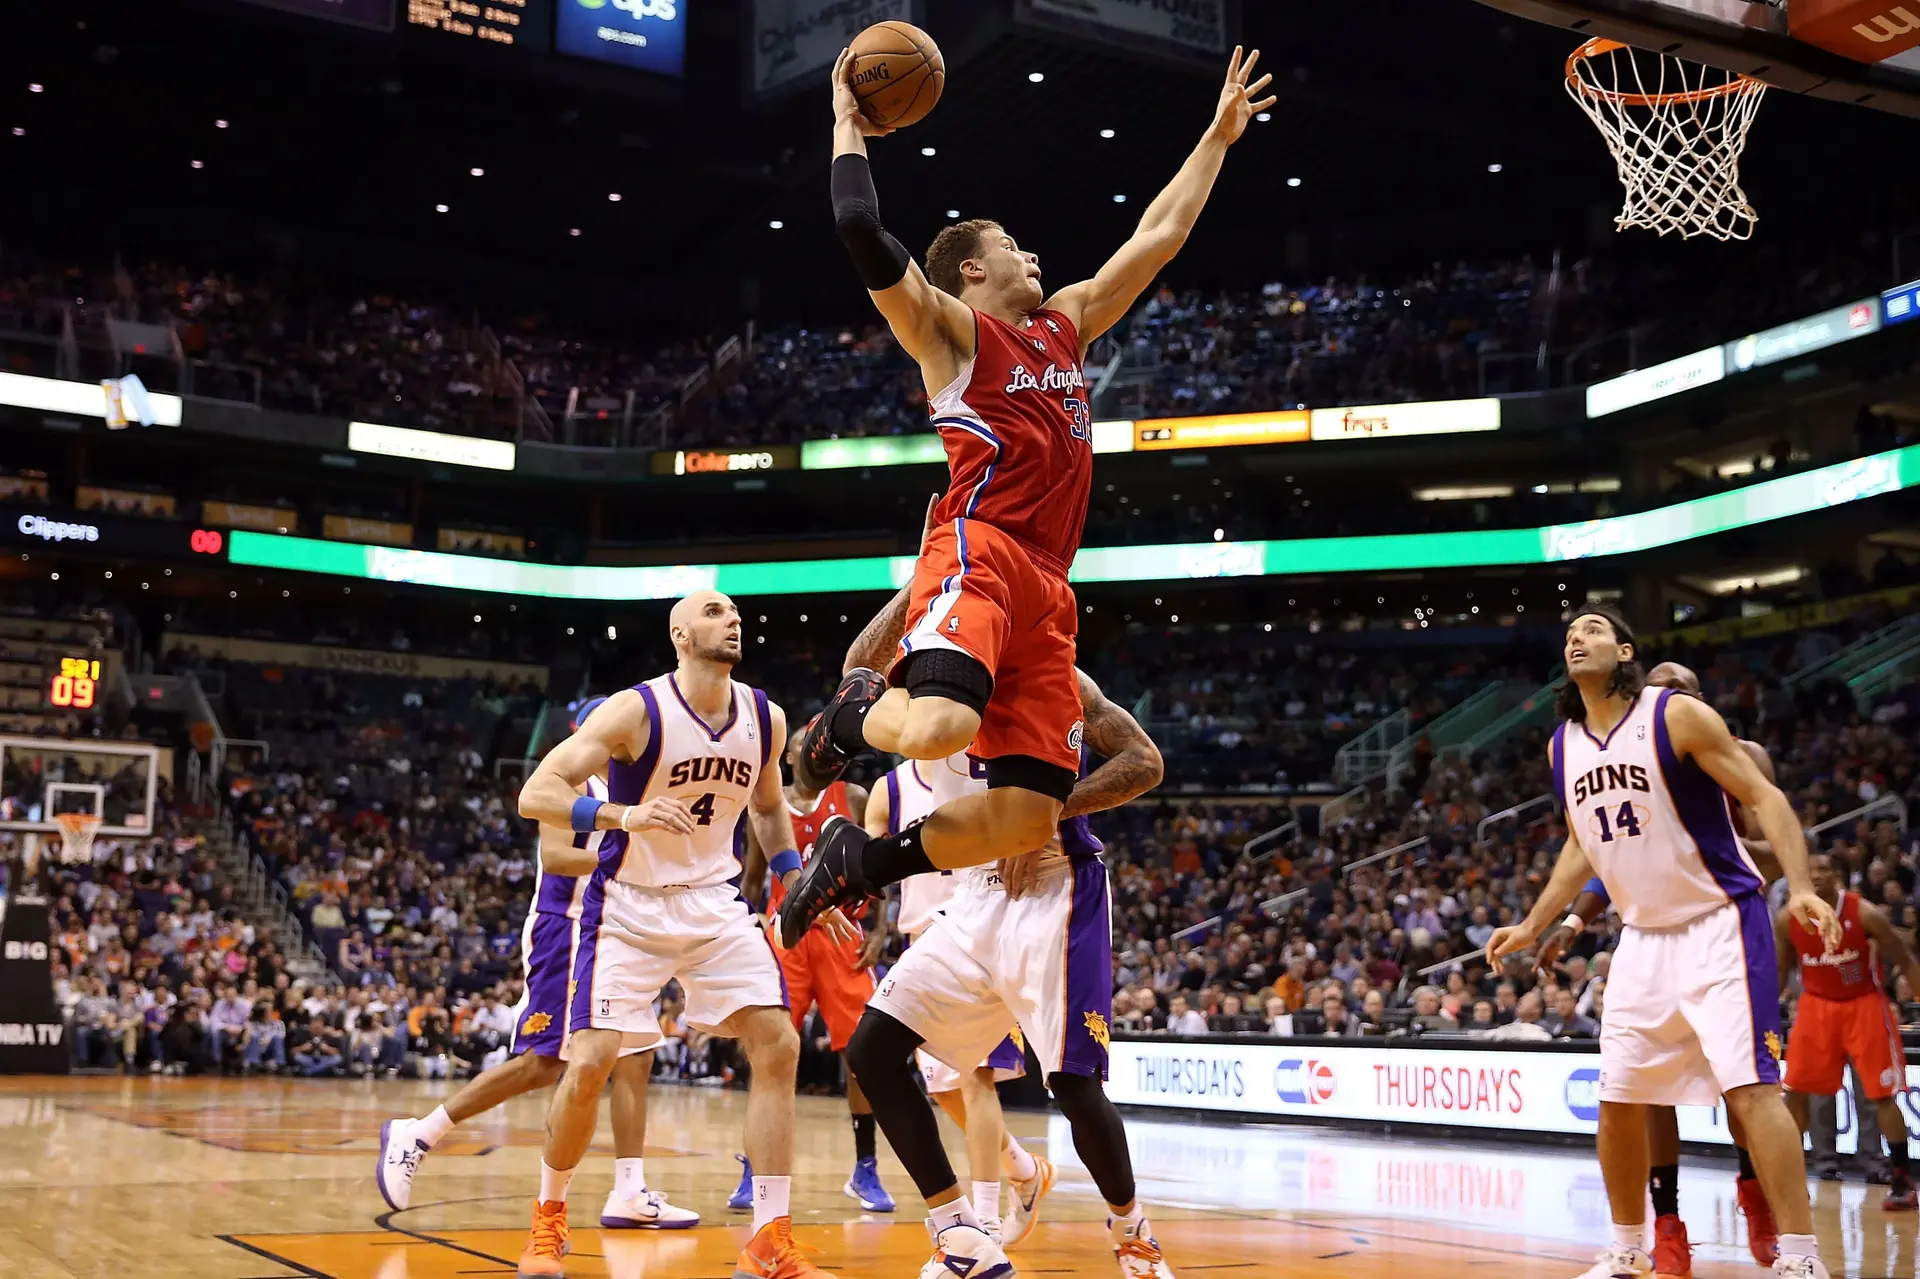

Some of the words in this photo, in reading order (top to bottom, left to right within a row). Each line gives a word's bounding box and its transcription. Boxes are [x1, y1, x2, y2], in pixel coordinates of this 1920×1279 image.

[1006, 365, 1040, 393] Los
[18, 514, 99, 541] Clippers
[51, 675, 95, 709] 09
[667, 756, 753, 789] SUNS
[1574, 763, 1651, 807] SUNS
[689, 792, 717, 827] 4
[1594, 800, 1642, 843] 14
[36, 1023, 64, 1046] TV
[1136, 1056, 1244, 1097] THURSDAYS
[1373, 1064, 1522, 1113] THURSDAYS
